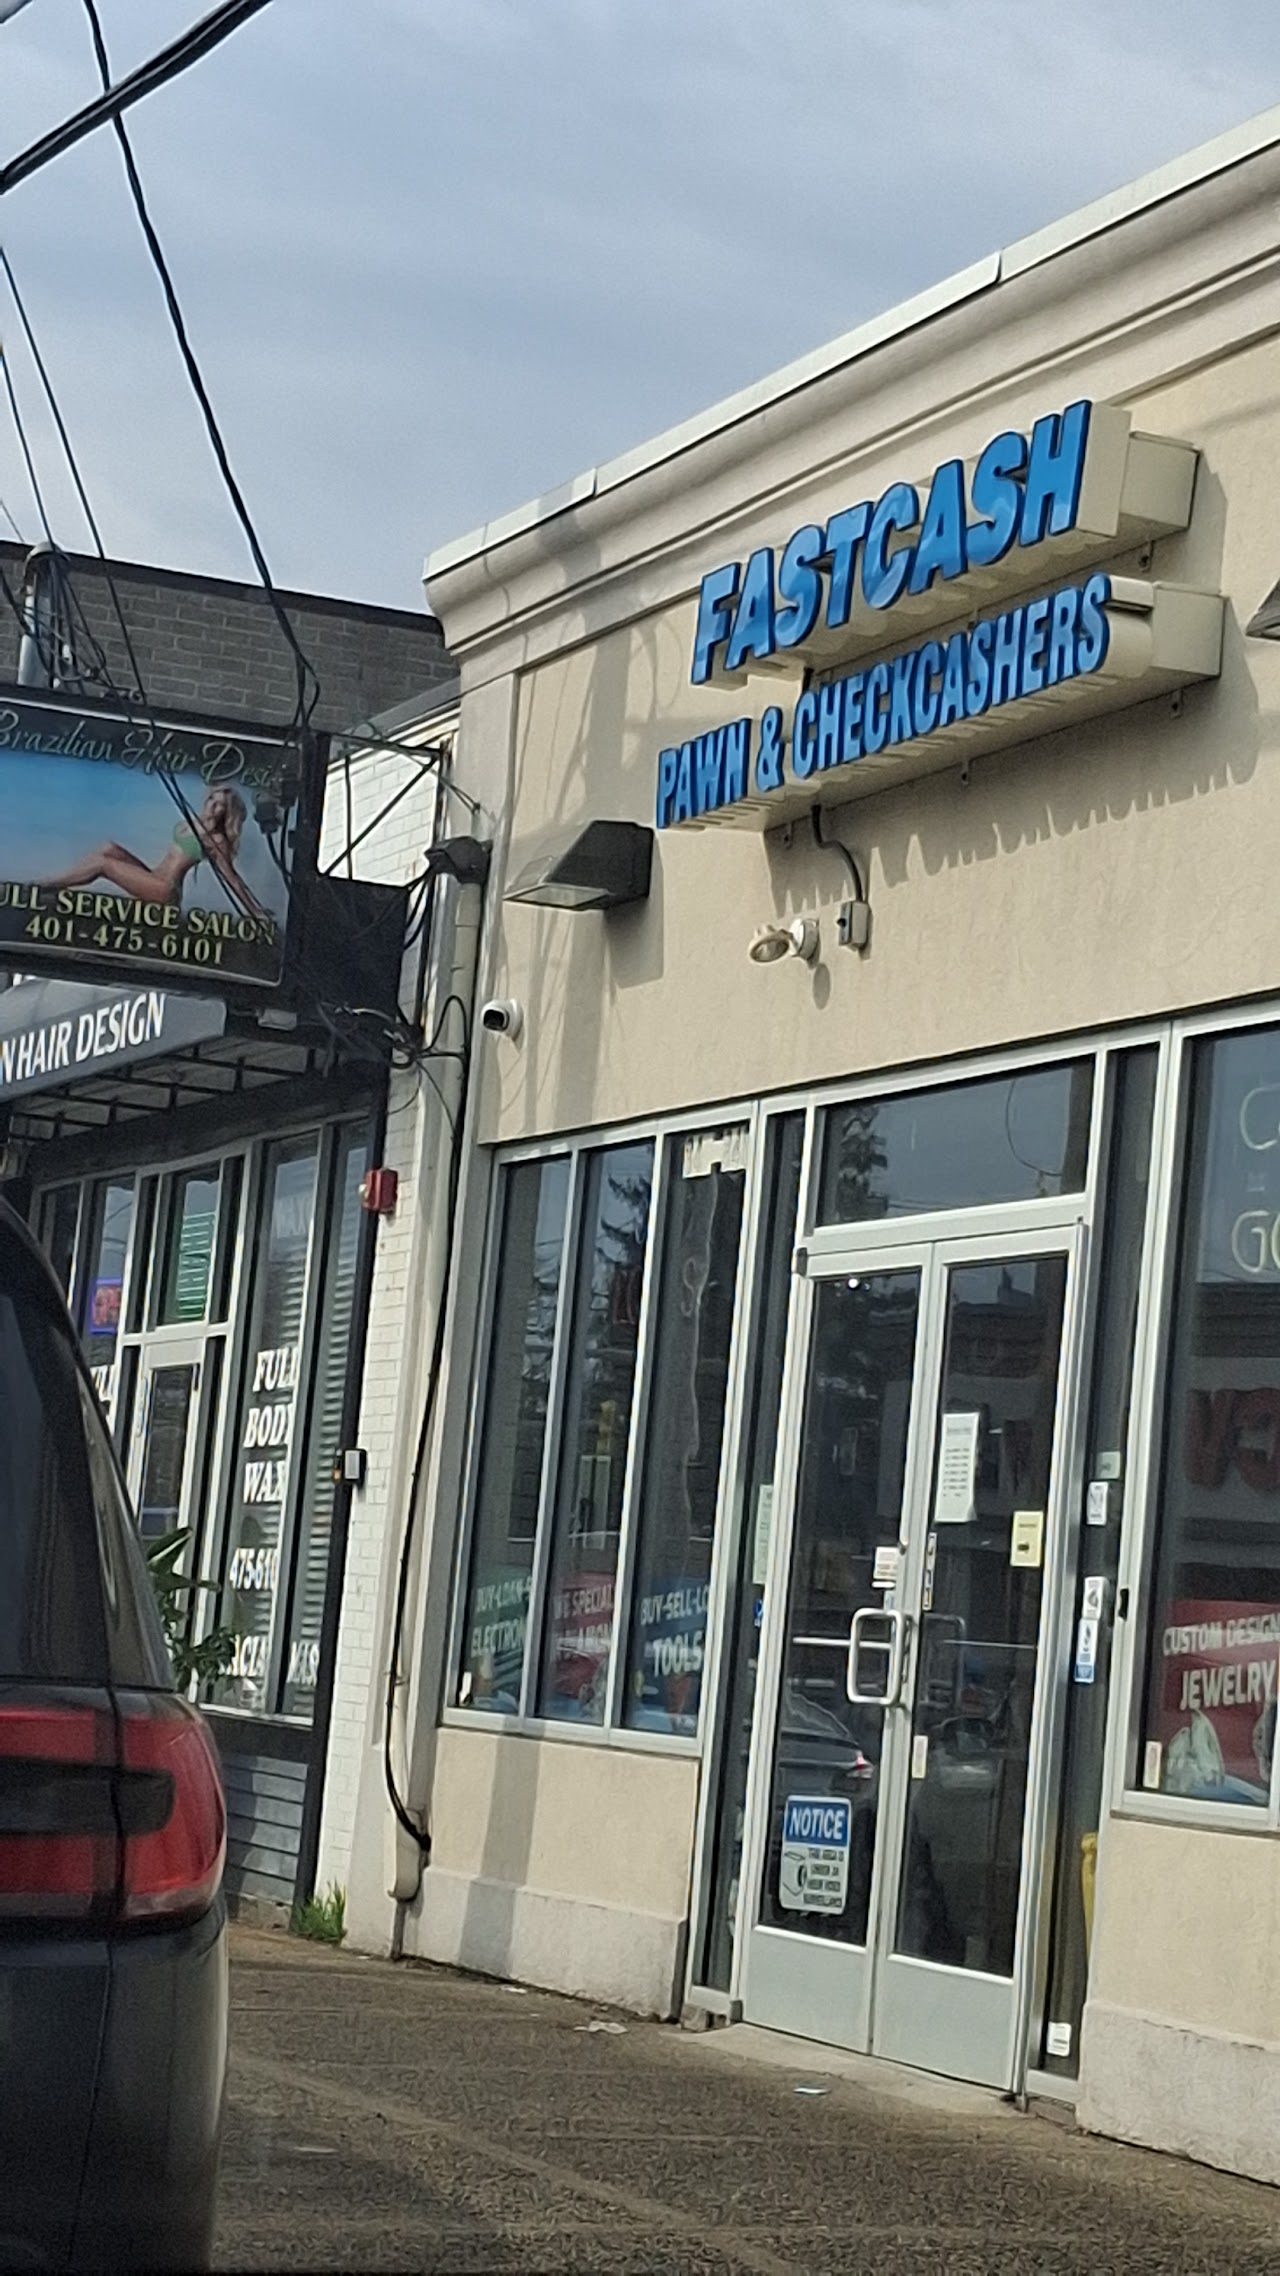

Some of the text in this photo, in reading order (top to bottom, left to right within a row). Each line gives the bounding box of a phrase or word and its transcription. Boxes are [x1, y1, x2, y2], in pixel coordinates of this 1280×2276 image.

[691, 400, 1092, 685] FASTCASH
[656, 571, 1110, 830] PAWN & CHECKCASHERS
[25, 915, 224, 965] 401-475-6101
[56, 889, 180, 931] SERVICE
[187, 906, 277, 947] SALON
[75, 991, 167, 1063] DESIGN
[652, 1629, 704, 1678] TOOLS
[1164, 1624, 1223, 1657] CUSTOM
[1179, 1659, 1277, 1712] JEWELRY
[789, 1806, 846, 1841] NOTICE
